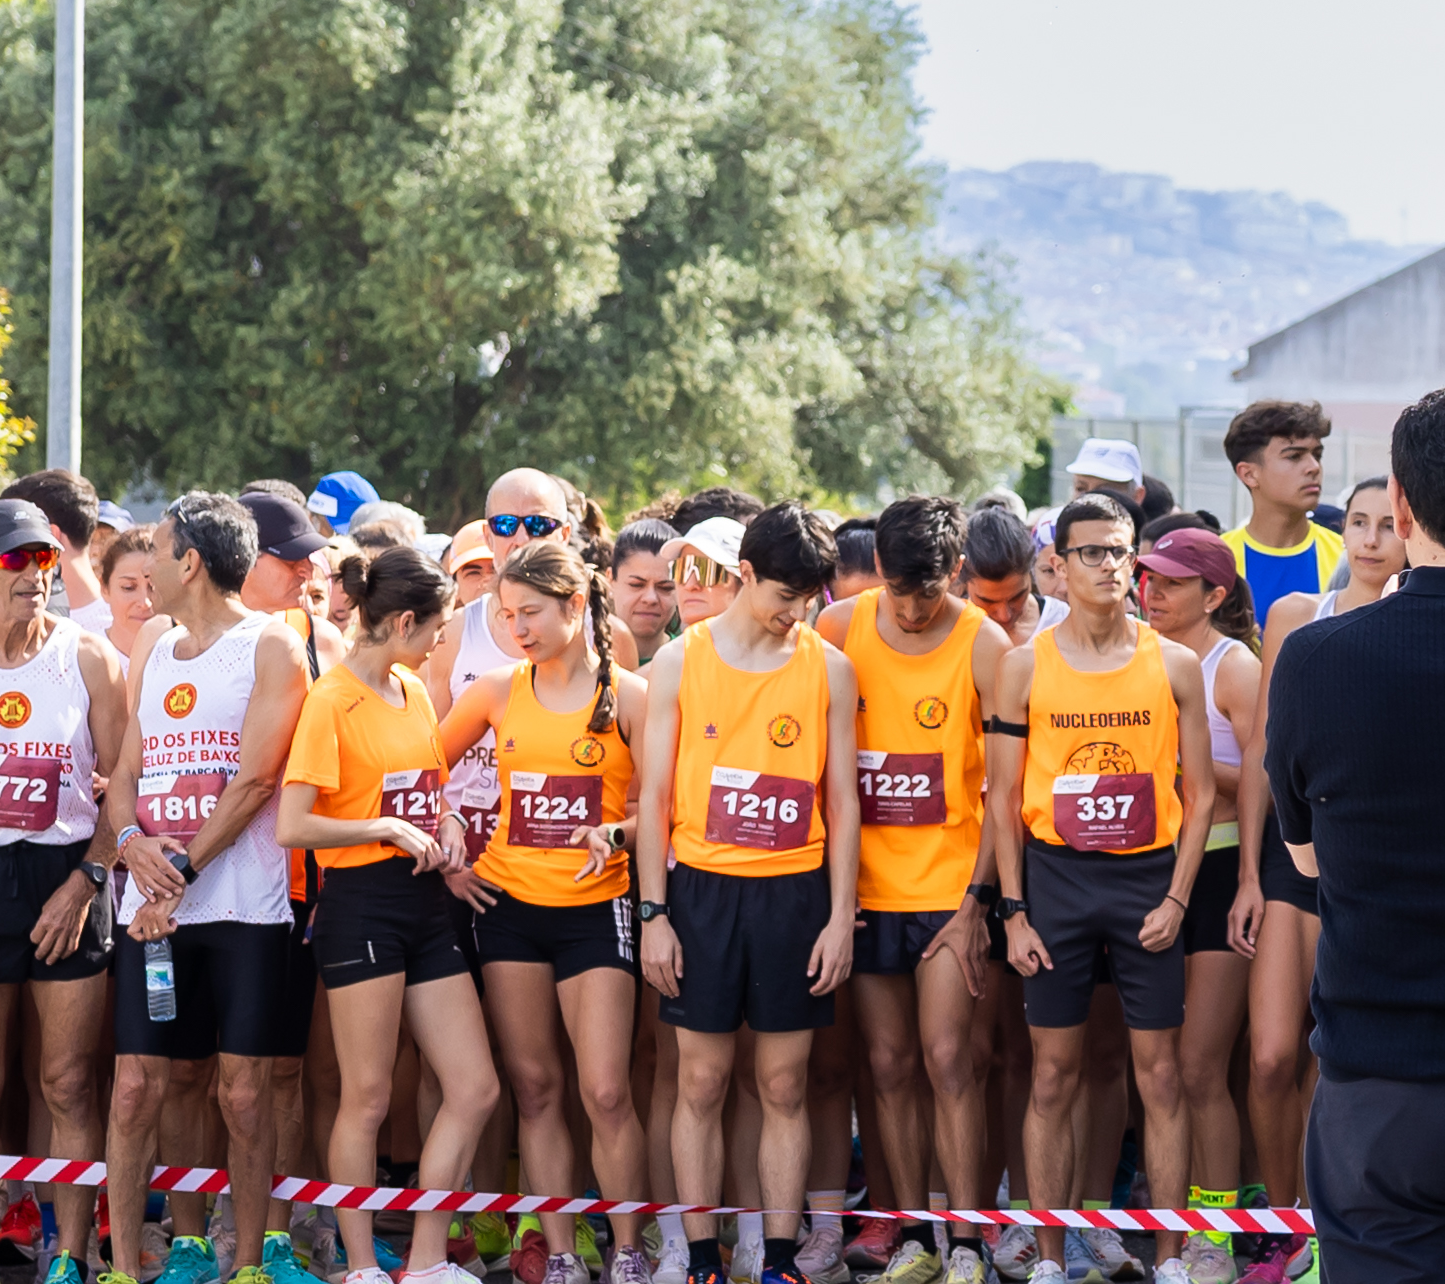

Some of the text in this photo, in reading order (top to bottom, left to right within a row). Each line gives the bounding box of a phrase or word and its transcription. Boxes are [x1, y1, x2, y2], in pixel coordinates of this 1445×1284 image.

[1050, 710, 1151, 728] NUCLEOEIRAS
[24, 742, 72, 759] FIXES
[163, 731, 186, 748] OS
[191, 730, 240, 747] FIXES
[177, 750, 196, 764] DE
[859, 773, 931, 798] 1222
[147, 794, 218, 821] 1816
[520, 795, 588, 820] 1224
[722, 791, 799, 823] 1216
[1076, 795, 1135, 821] 337
